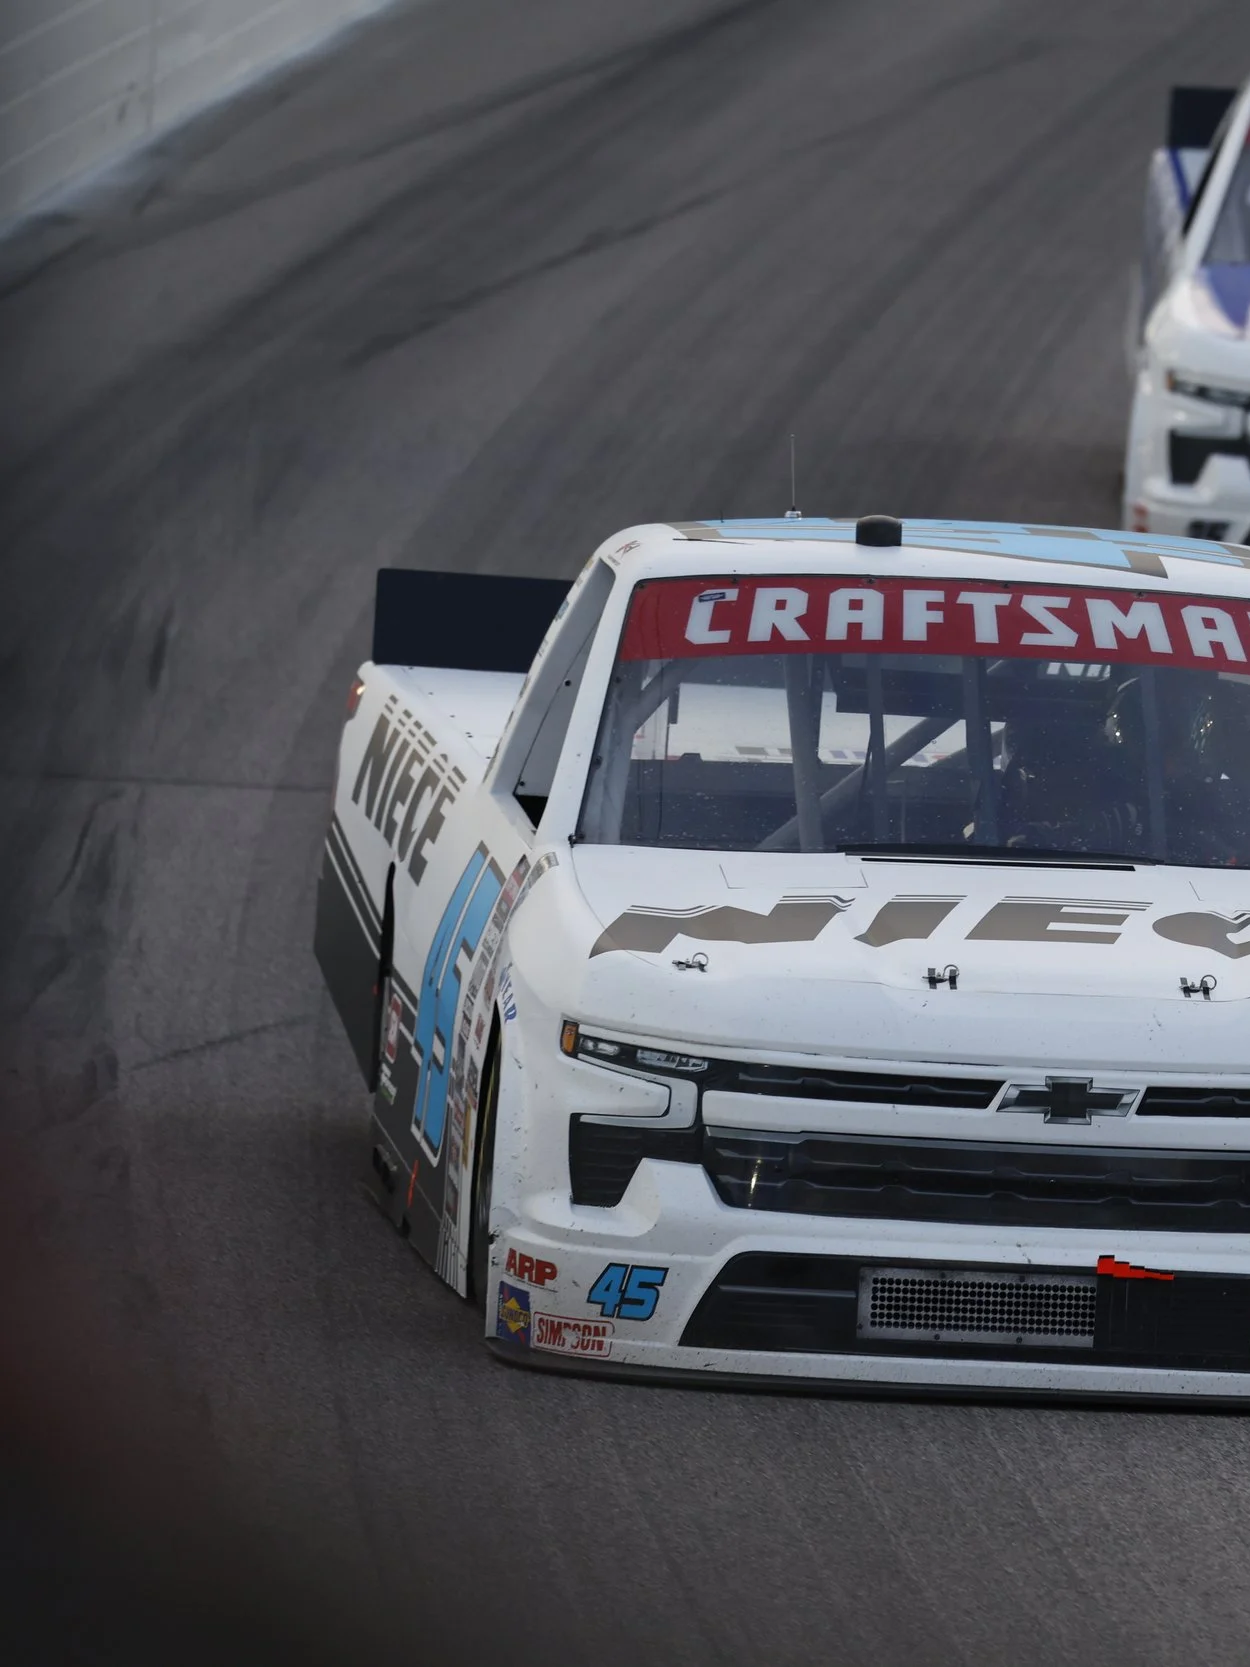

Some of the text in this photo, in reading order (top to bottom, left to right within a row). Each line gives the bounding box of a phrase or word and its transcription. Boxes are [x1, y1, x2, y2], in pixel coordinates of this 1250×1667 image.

[351, 694, 468, 887] NIECE
[505, 1247, 557, 1286] ARP
[586, 1262, 670, 1322] 45
